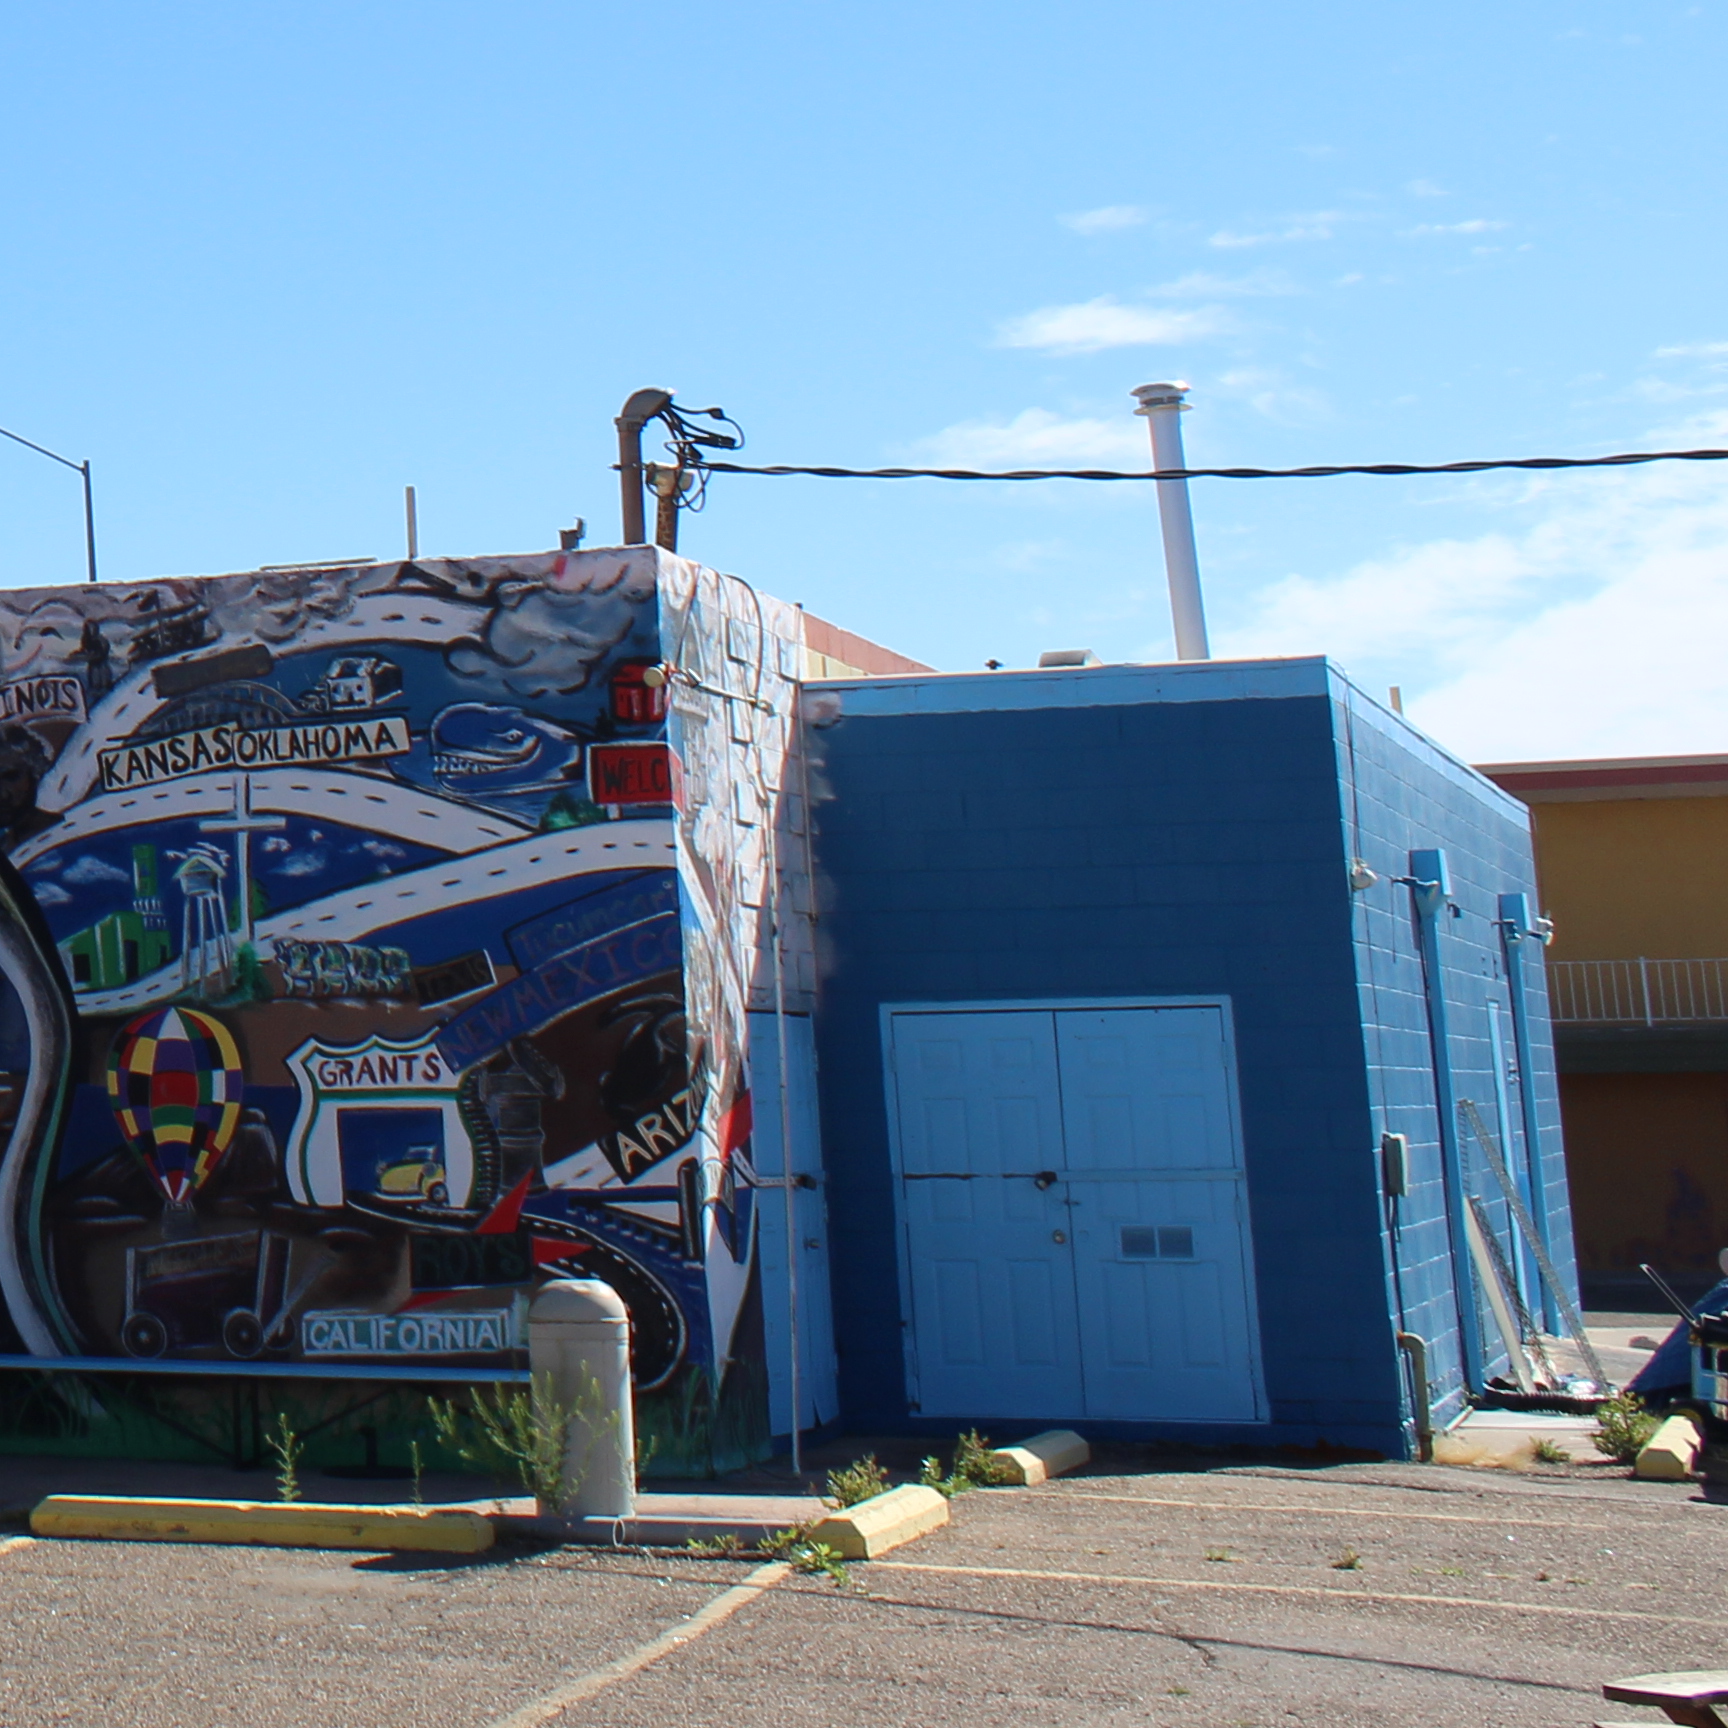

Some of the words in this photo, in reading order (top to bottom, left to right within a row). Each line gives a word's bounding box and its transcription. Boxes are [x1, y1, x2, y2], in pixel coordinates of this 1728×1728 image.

[103, 725, 232, 787] KANSAS
[236, 725, 398, 762] OKLAHOMA
[601, 756, 665, 795] WELC
[318, 1051, 442, 1088] GRANTS
[617, 1078, 699, 1175] ARIZ
[309, 1317, 500, 1352] CALIFORNIA
